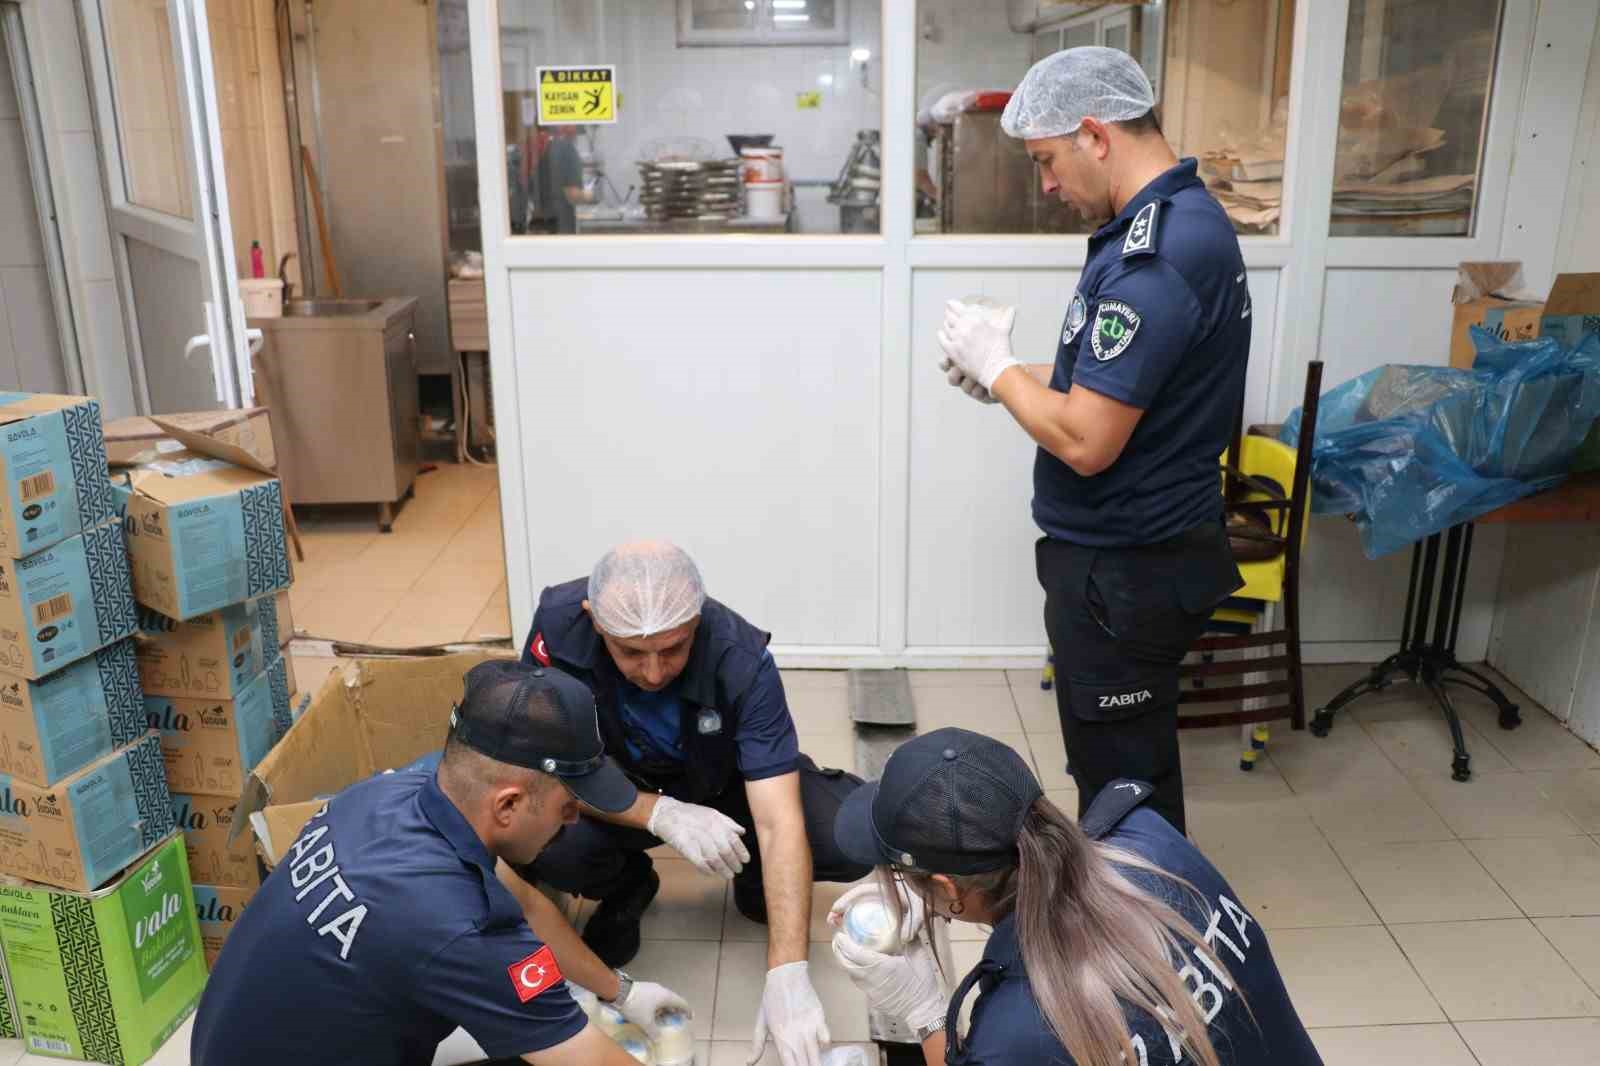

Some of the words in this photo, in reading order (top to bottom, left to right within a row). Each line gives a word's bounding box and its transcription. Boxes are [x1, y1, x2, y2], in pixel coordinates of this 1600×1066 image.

[545, 92, 579, 101] KAYGAN
[1098, 689, 1153, 707] ZABITA
[146, 704, 193, 733] ala
[290, 803, 368, 960] ABITA
[135, 891, 183, 949] vala
[196, 897, 238, 922] ala
